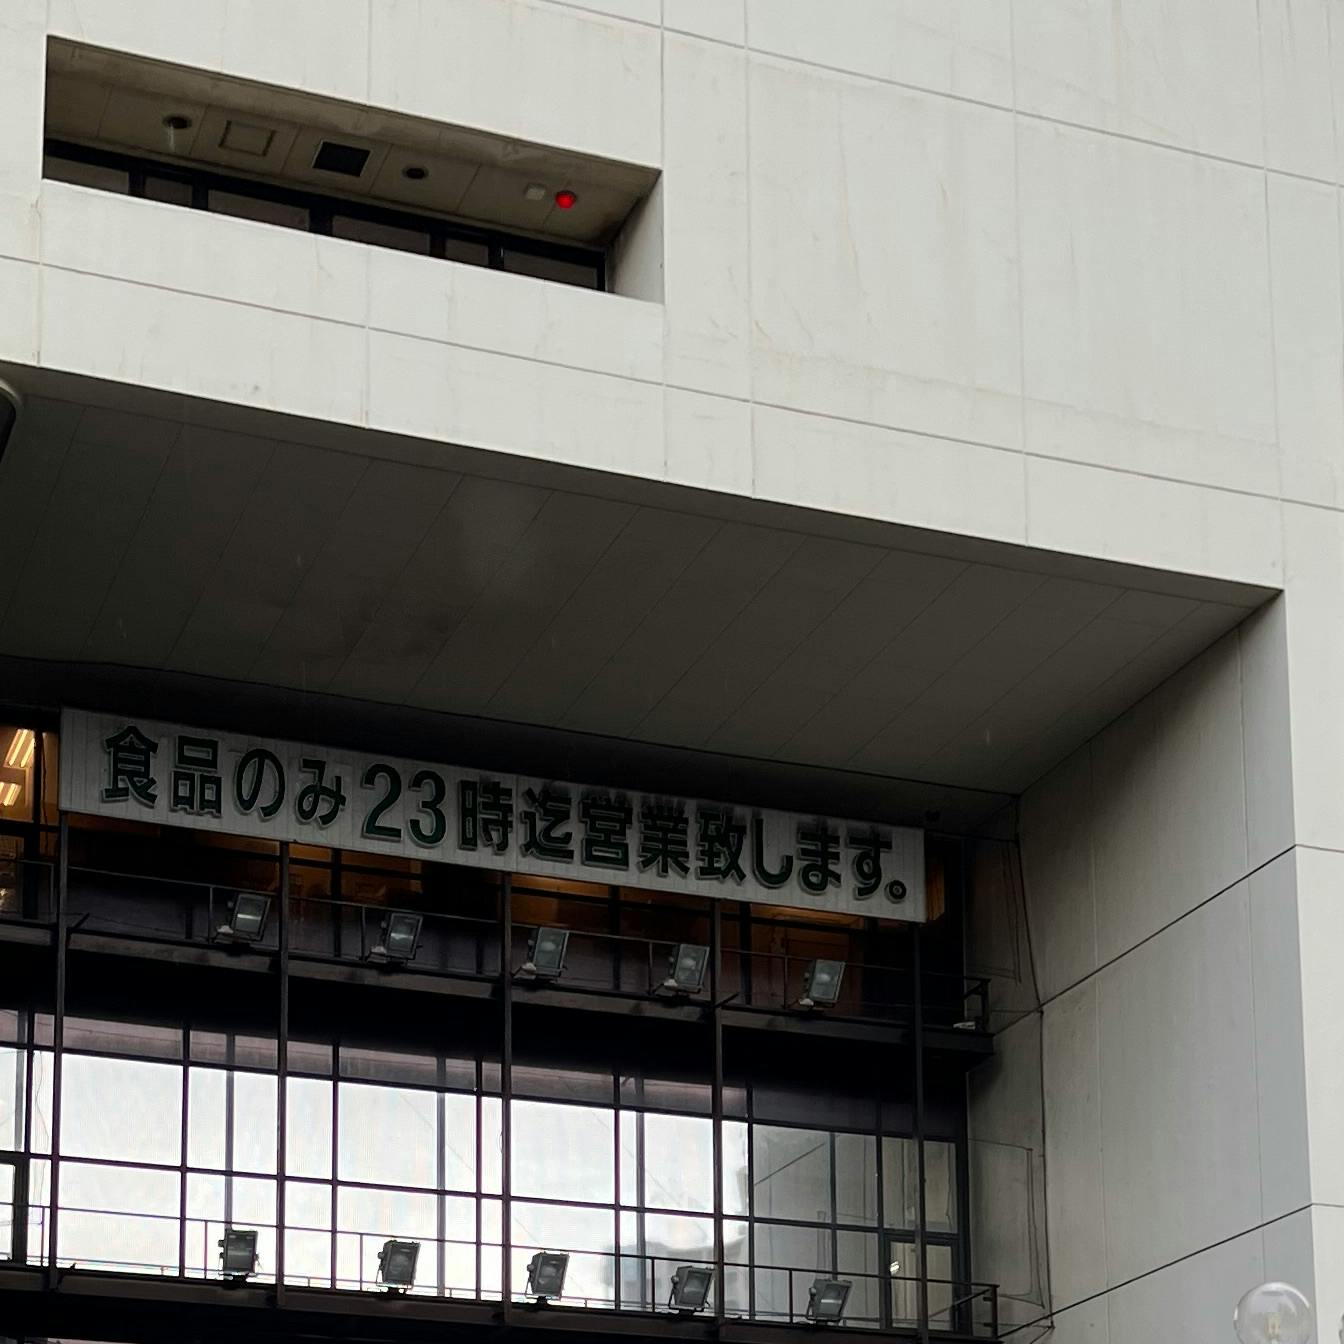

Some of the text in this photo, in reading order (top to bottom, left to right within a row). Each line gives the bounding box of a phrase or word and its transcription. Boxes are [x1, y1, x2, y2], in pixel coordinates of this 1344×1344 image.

[100, 724, 908, 904] 食品のみ23時迄営業致します。
